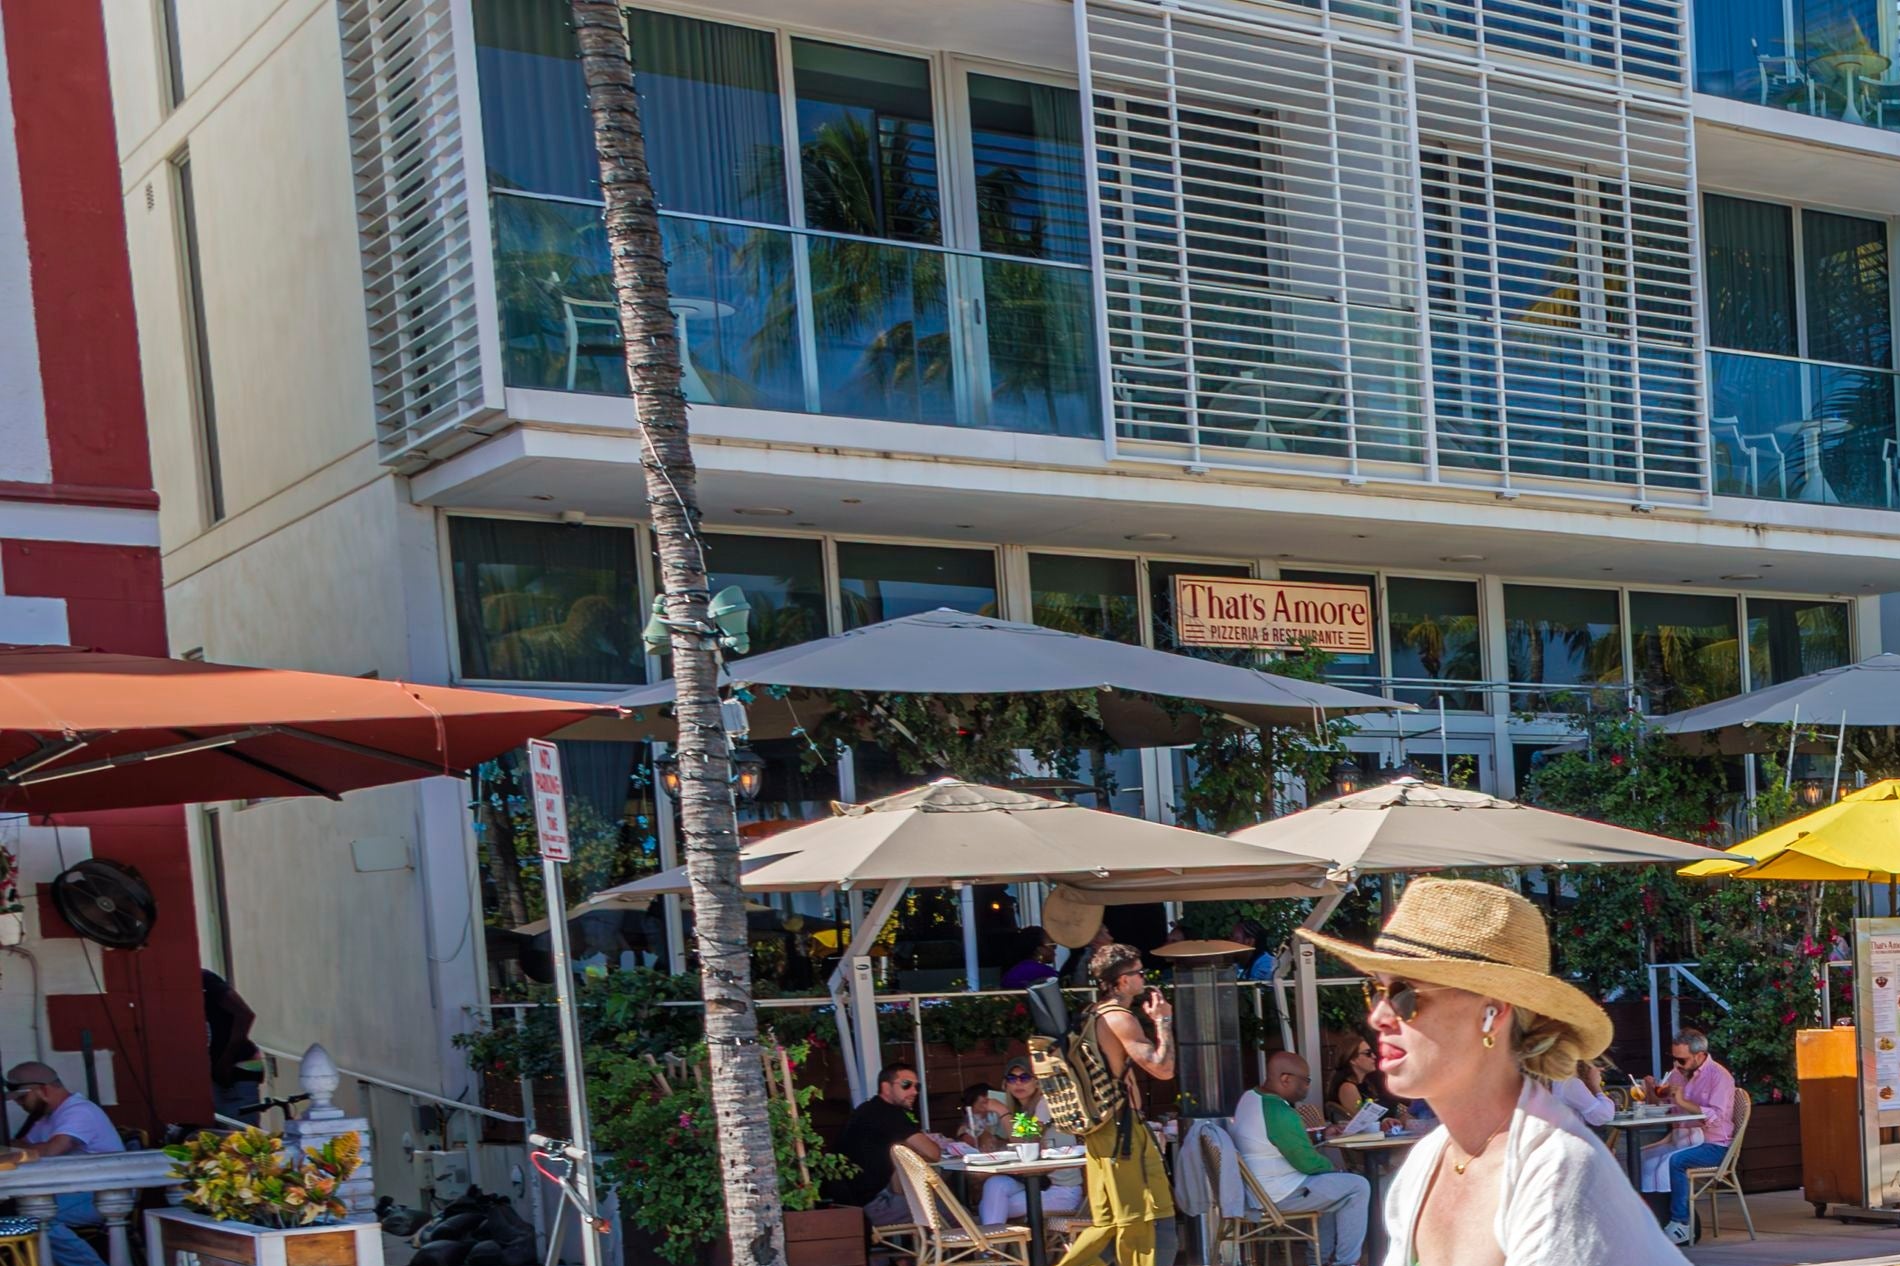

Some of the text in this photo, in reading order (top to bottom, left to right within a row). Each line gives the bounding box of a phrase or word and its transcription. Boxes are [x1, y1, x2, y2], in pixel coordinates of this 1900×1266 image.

[1182, 583, 1366, 626] That's Amore
[1211, 625, 1259, 641] PIZZERIA
[1262, 627, 1269, 641] &
